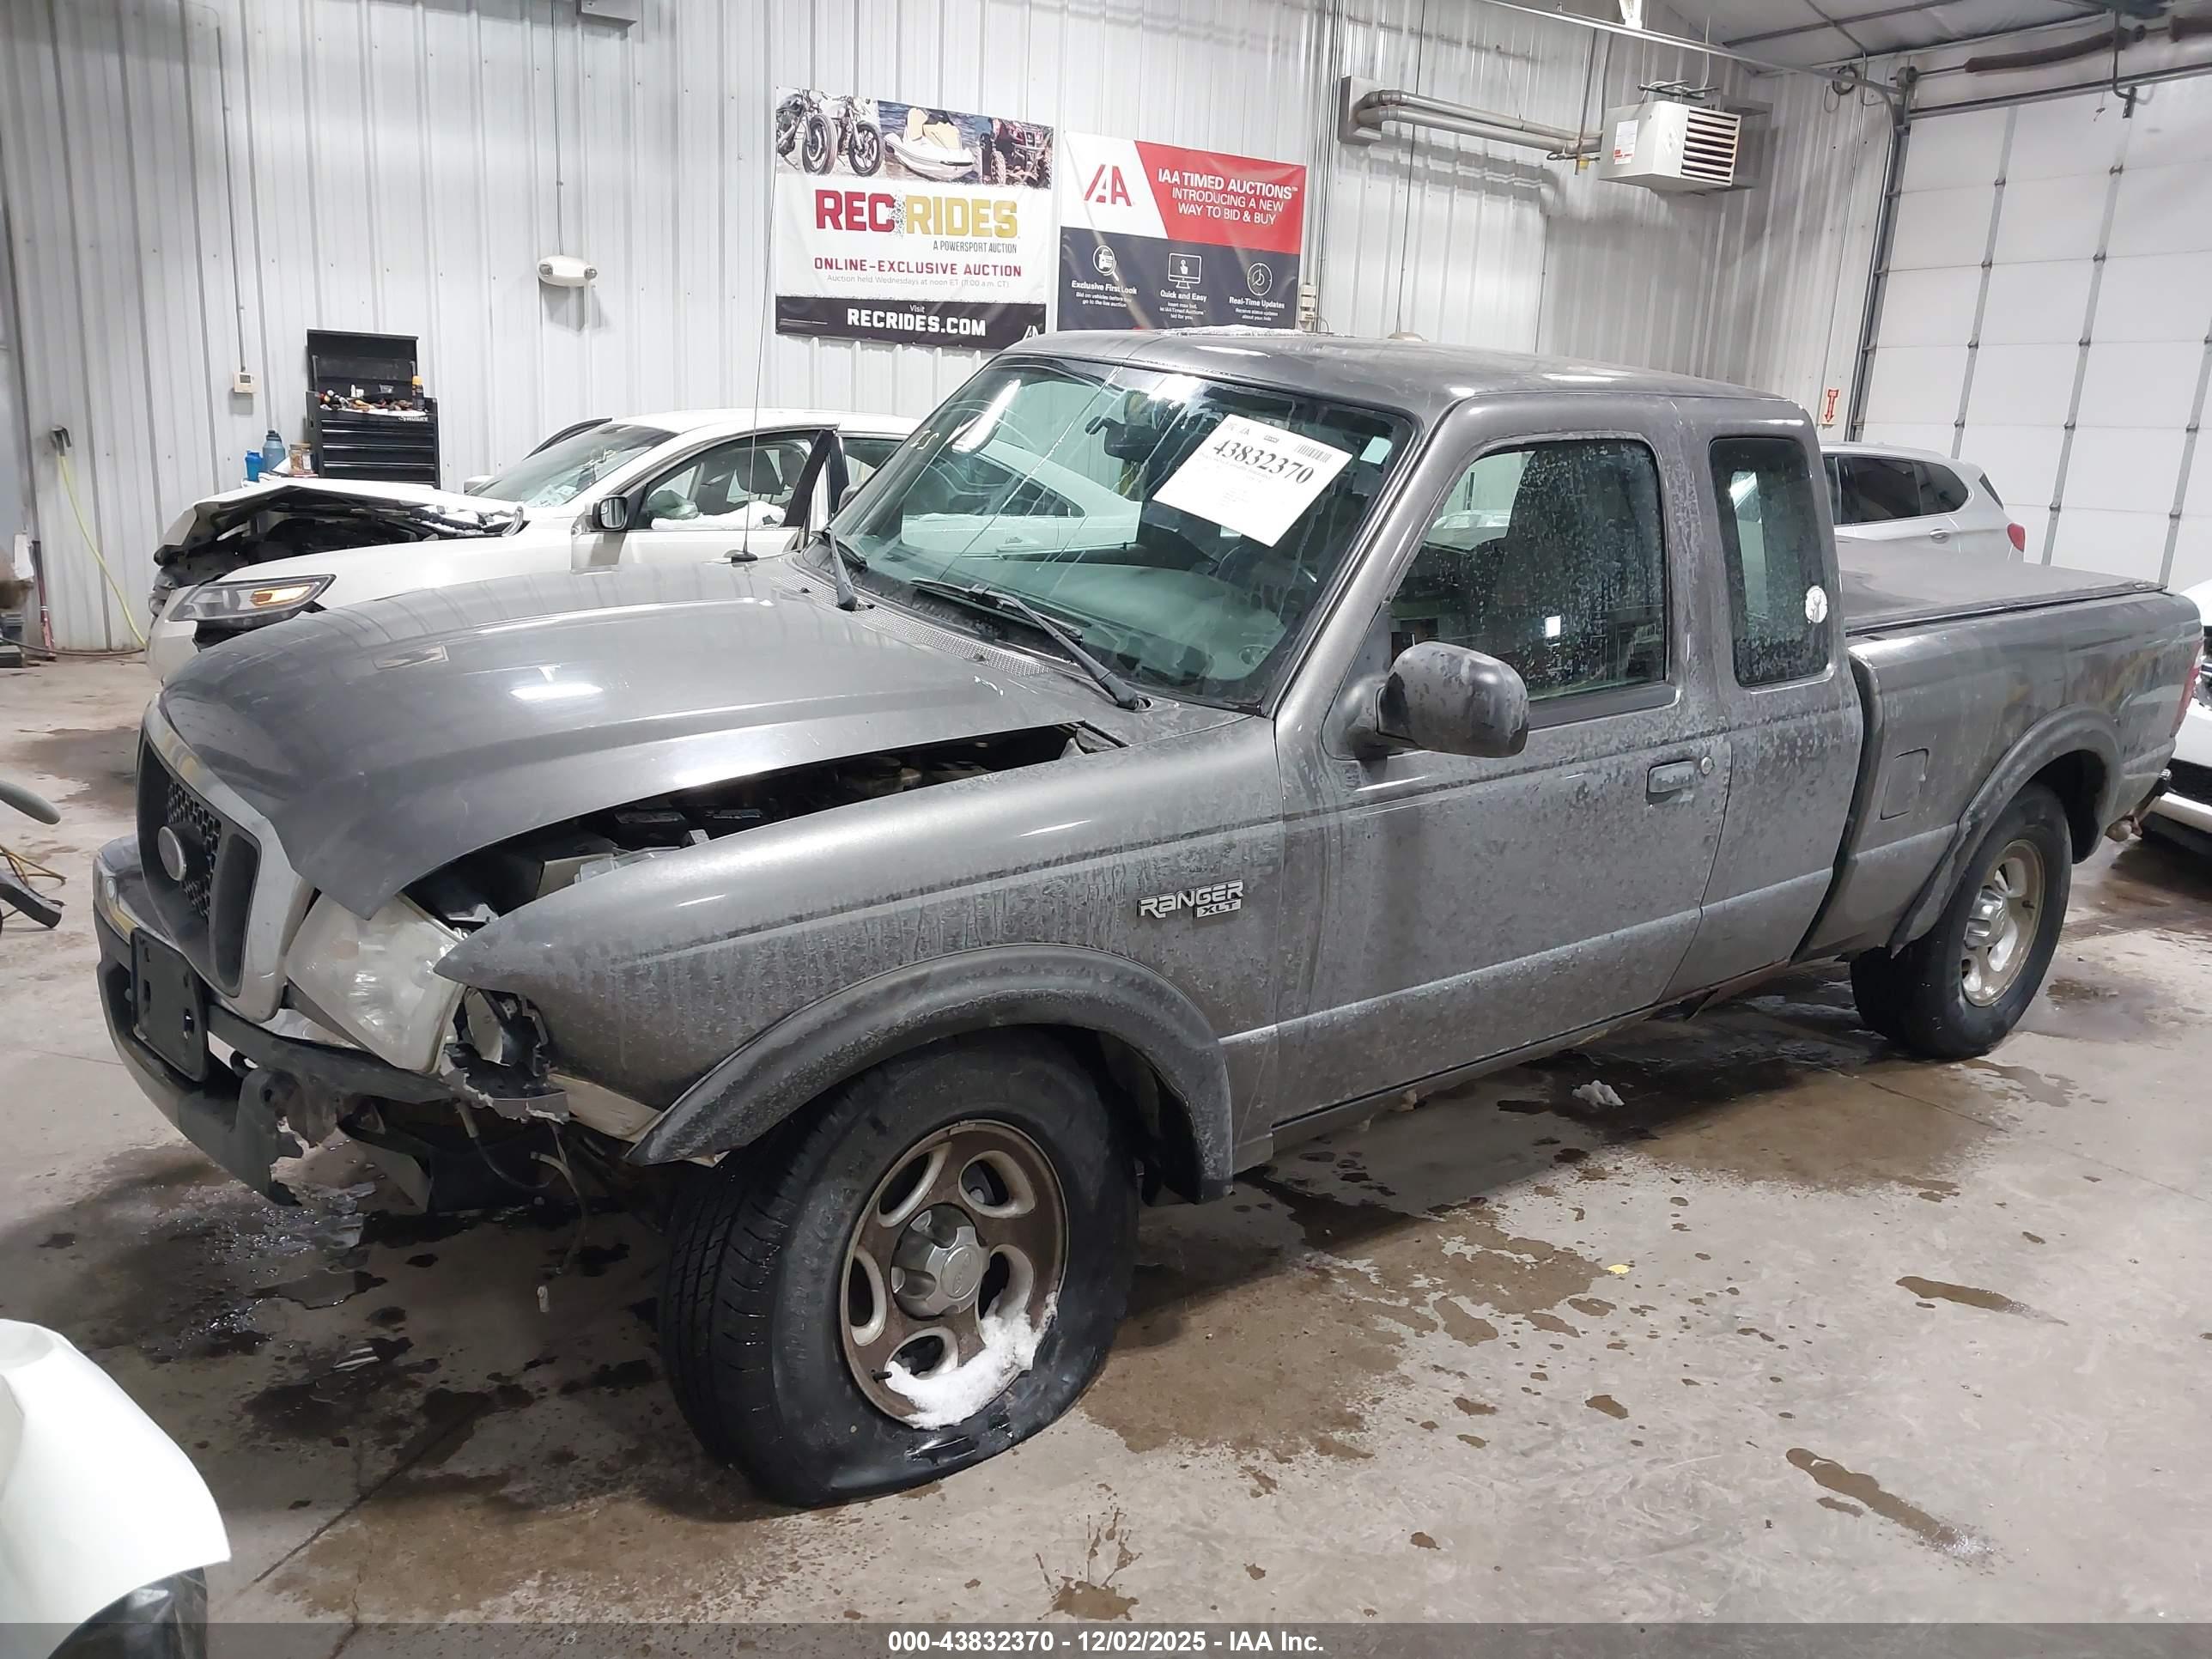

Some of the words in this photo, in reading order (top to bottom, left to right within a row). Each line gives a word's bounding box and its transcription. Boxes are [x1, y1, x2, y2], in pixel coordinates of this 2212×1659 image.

[1158, 167, 1181, 185] IAA
[1182, 172, 1224, 191] TIMED
[1172, 187, 1246, 208] INTRODUCING
[1248, 198, 1256, 209] A
[1259, 199, 1284, 212] NEW
[1178, 203, 1204, 216] WAY
[1206, 205, 1221, 218] TO
[1224, 209, 1241, 221] BID
[1243, 211, 1251, 222] &
[1254, 212, 1277, 225] BUY
[933, 240, 939, 251] A
[940, 240, 988, 252] POWERSPORT
[988, 243, 1018, 254] AUCTION
[814, 257, 957, 275] ONLINE-EXCLUSIVE
[963, 264, 1022, 276] AUCTION
[857, 275, 873, 283] held
[875, 276, 919, 286] Wednesdays
[1071, 280, 1104, 291] Exclusive
[1105, 283, 1121, 292] First
[1121, 286, 1138, 295] Look
[1160, 289, 1176, 299] Quick
[1192, 293, 1207, 302] Easy
[1229, 296, 1261, 307] Real-Time
[1261, 300, 1285, 309] Updates
[910, 304, 925, 313] Visit
[847, 308, 986, 337] RECRIDES.COM
[1213, 439, 1315, 484] 43832370
[1139, 879, 1244, 919] RANGER
[1201, 901, 1237, 915] XLT
